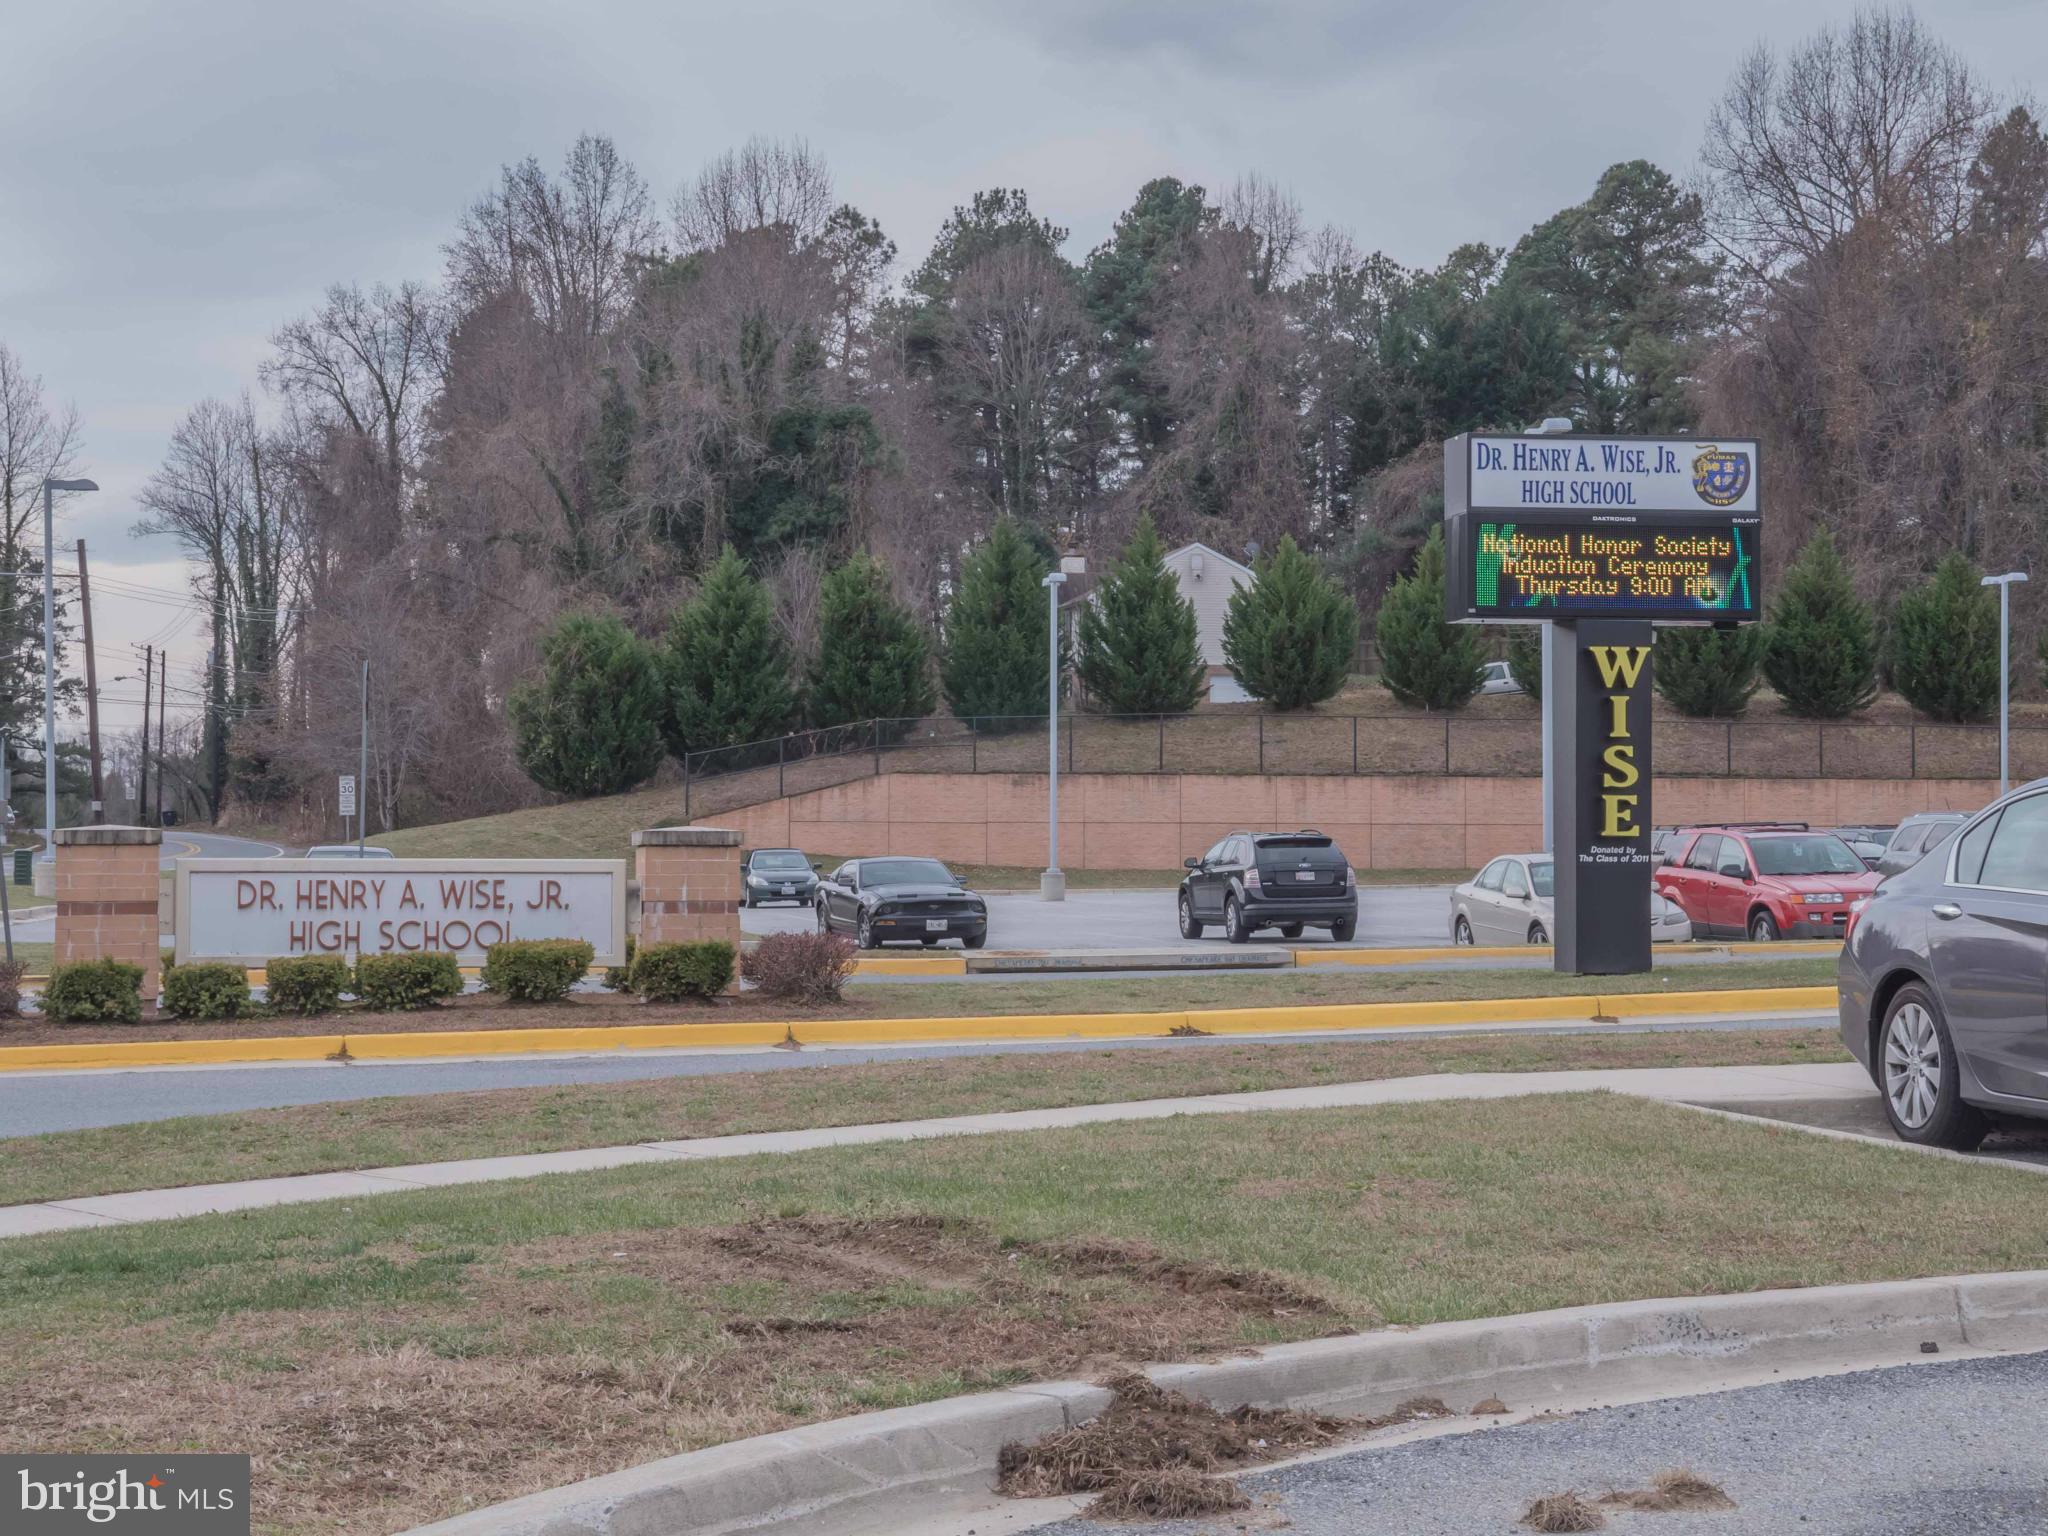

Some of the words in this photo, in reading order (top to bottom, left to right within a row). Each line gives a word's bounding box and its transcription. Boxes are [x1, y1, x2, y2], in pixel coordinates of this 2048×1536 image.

[1476, 442, 1508, 471] DR.
[1512, 443, 1572, 473] HENRY
[1575, 445, 1595, 473] A.
[1600, 444, 1650, 477] WISE,
[1654, 445, 1681, 474] JR.
[1521, 480, 1565, 503] HIGH
[1569, 481, 1637, 505] SCHOOL
[1483, 533, 1569, 554] National
[1581, 534, 1642, 554] Honor
[1655, 535, 1732, 556] Society
[1502, 554, 1596, 574] Induction
[1608, 555, 1709, 576] Ceremony
[1515, 575, 1619, 595] Thursday
[1630, 576, 1672, 596] 9:00
[1684, 577, 1712, 596] AM
[1589, 646, 1652, 837] WISE
[341, 785, 354, 794] 30
[1579, 854, 1594, 862] The
[1595, 854, 1618, 862] Class
[1620, 855, 1630, 863] of
[1631, 855, 1650, 863] 2011
[1590, 845, 1625, 854] Donated
[1626, 846, 1637, 856] by
[237, 879, 284, 911] DR.
[295, 879, 386, 911] HENRY
[399, 879, 425, 911] A.
[439, 879, 514, 914] WISE,
[526, 879, 570, 911] JR.
[289, 920, 361, 951] HIGH
